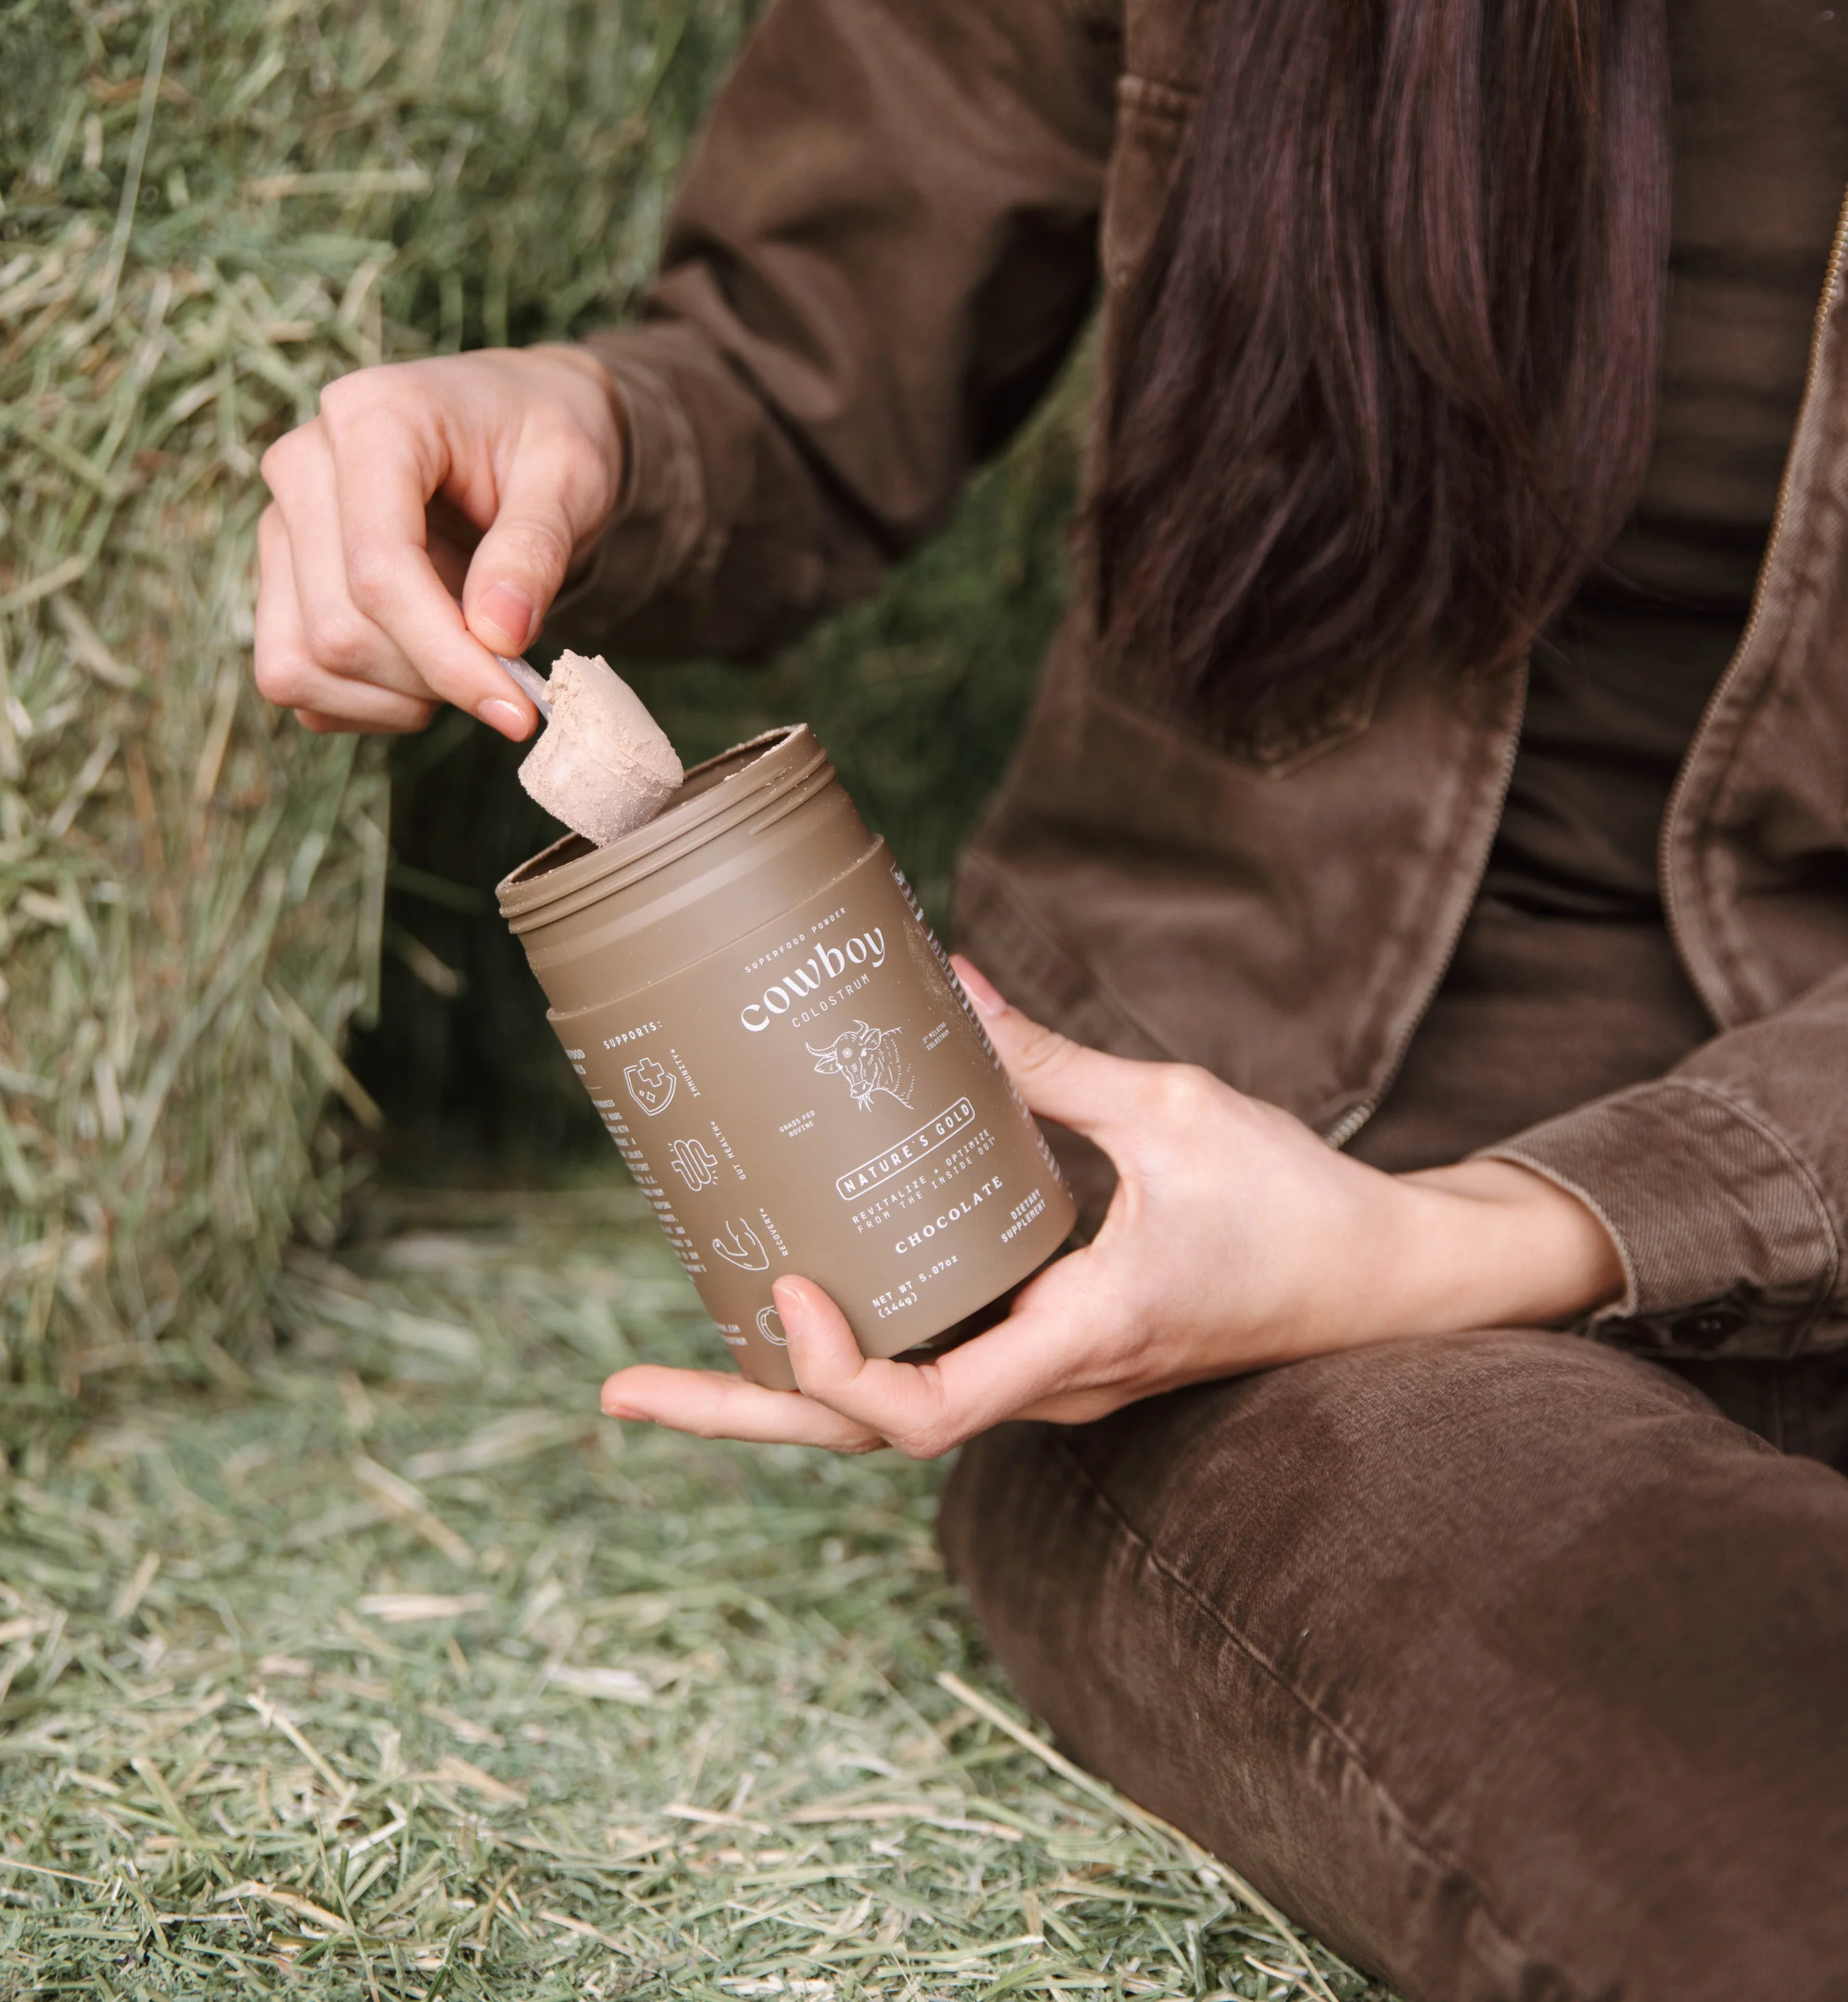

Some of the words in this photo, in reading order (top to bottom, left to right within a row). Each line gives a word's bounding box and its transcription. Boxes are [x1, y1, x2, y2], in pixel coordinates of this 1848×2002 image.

[745, 934, 806, 973] SUPERFOOD
[811, 907, 847, 934] POWDER
[741, 927, 885, 1032] cowboy
[792, 973, 871, 1027] COLOSTRUM
[603, 1021, 663, 1050] SUPPORTS:
[926, 1029, 950, 1051] COLOSTRUM
[928, 1021, 947, 1039] MILKING
[779, 1118, 801, 1133] GRASS
[801, 1109, 816, 1121] FED
[788, 1120, 815, 1138] BOVINE
[843, 1135, 929, 1193] NATURE'S
[935, 1103, 970, 1135] GOLD
[733, 1164, 747, 1181] GUT
[851, 1175, 927, 1224] REVITALIZE
[945, 1129, 990, 1166] OPTIMIZE
[857, 1211, 891, 1234] FROM
[899, 1191, 923, 1209] THE
[931, 1156, 973, 1190] INSIDE
[895, 1175, 1003, 1254] CHOCOLATE
[1001, 1198, 1047, 1243] SUPPLEMENT
[1010, 1188, 1041, 1220] DIETARY
[872, 1292, 893, 1308] NET
[898, 1281, 913, 1294] WT
[918, 1255, 958, 1283] 5.07oz
[878, 1292, 918, 1318] (144g)
